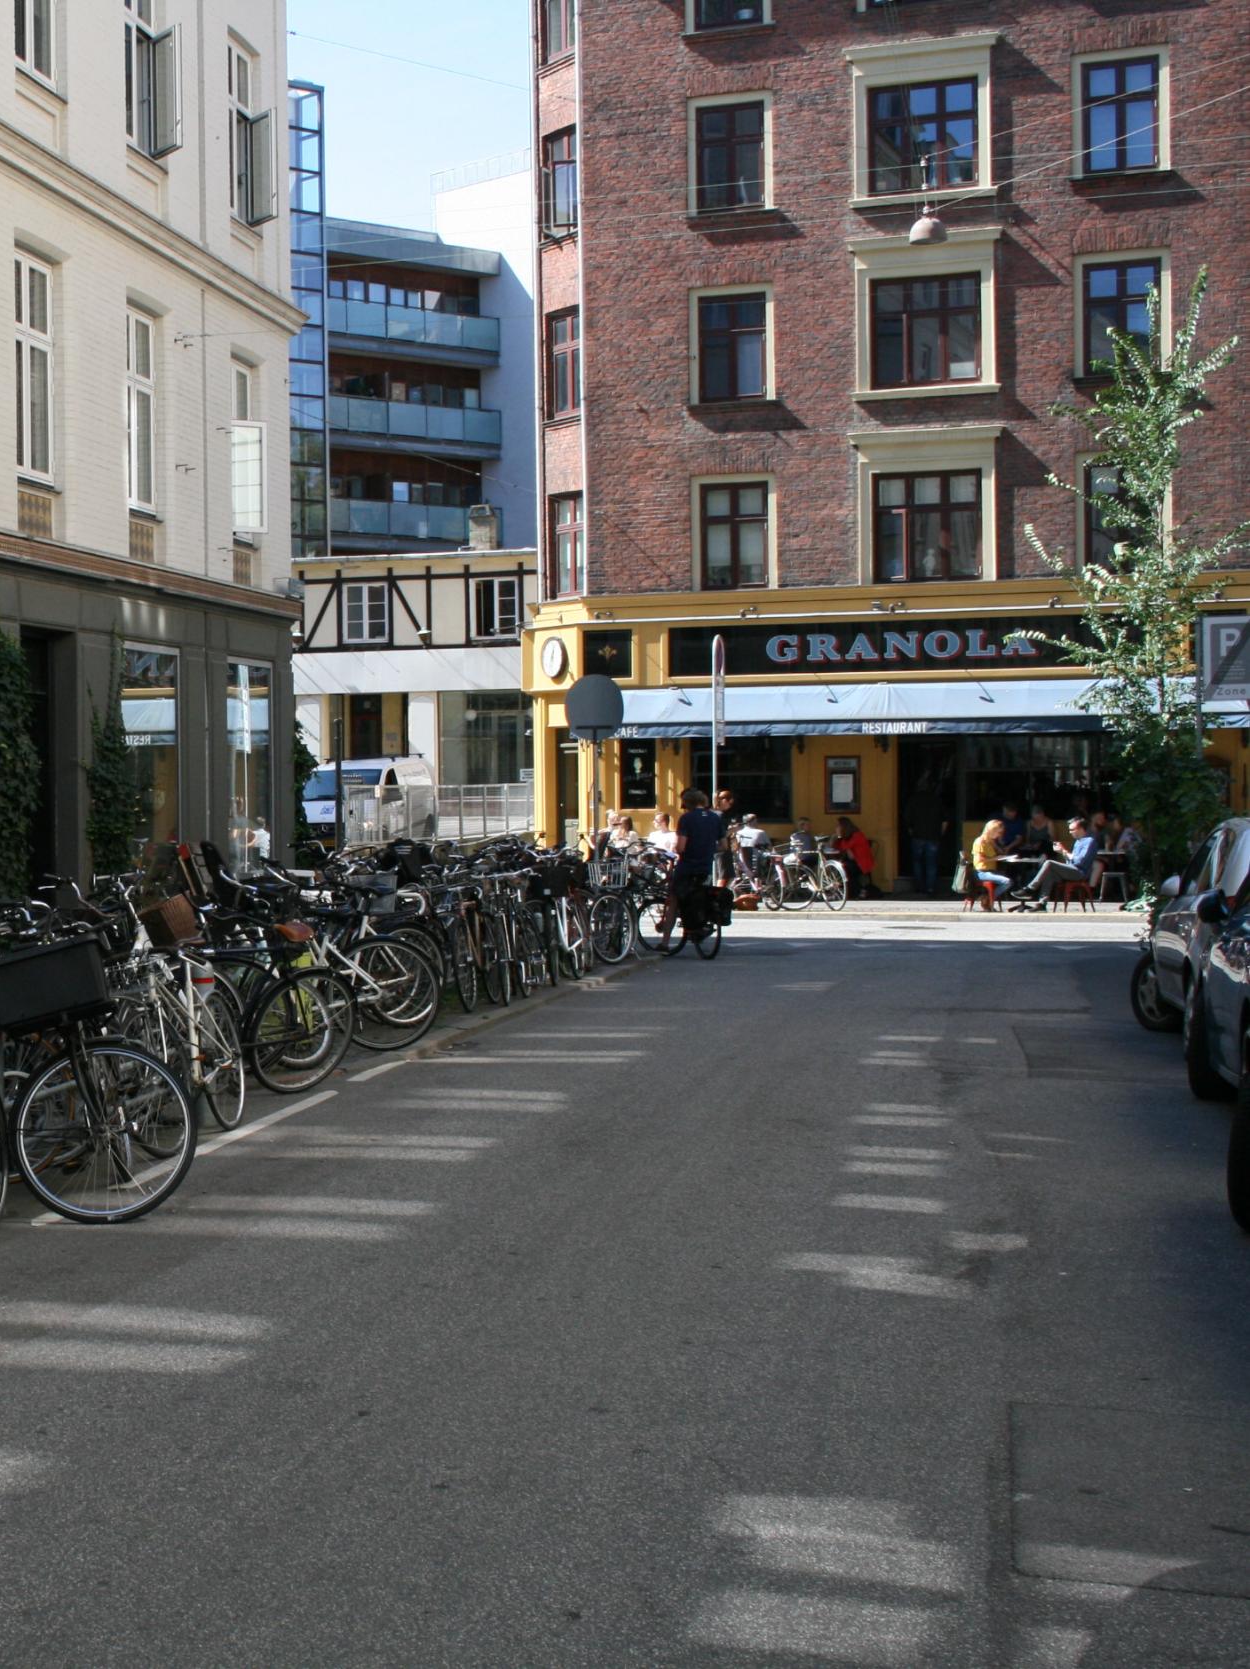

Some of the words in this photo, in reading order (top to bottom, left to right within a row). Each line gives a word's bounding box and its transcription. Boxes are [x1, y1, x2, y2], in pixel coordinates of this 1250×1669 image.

[765, 628, 1038, 663] GRANOLA
[1219, 628, 1240, 657] P
[1216, 686, 1246, 697] Zone
[862, 721, 927, 734] RESTAURANT
